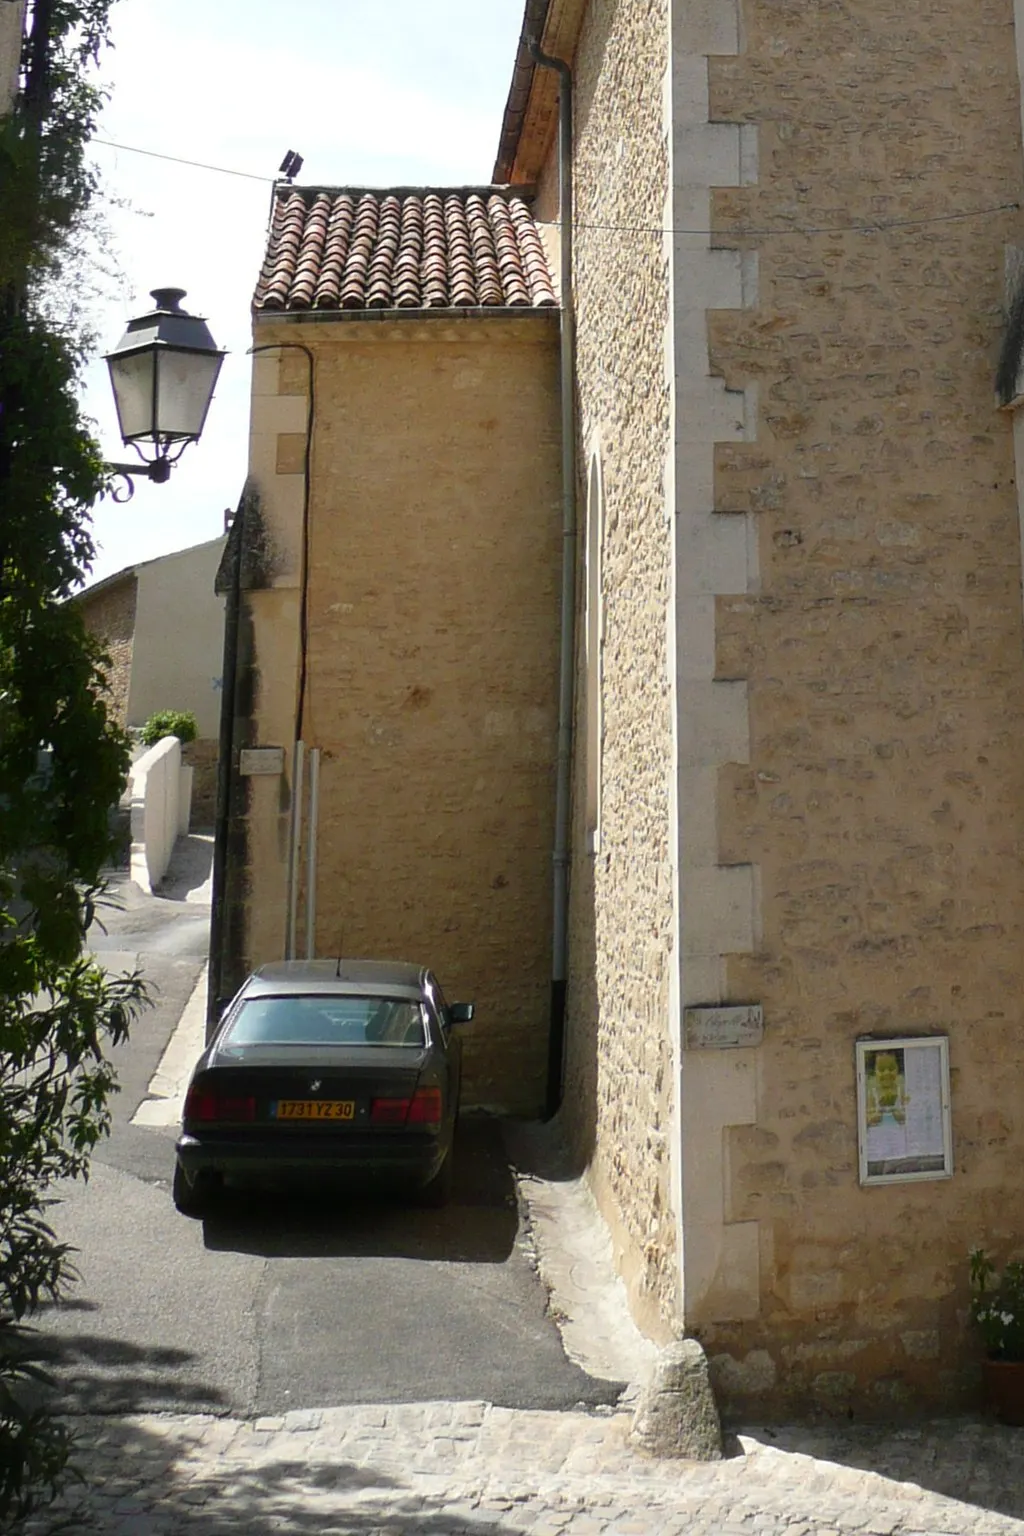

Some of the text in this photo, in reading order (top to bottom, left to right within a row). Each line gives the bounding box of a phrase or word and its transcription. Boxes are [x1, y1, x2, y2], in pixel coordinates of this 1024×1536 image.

[281, 1103, 352, 1116] 1731 YZ 30
